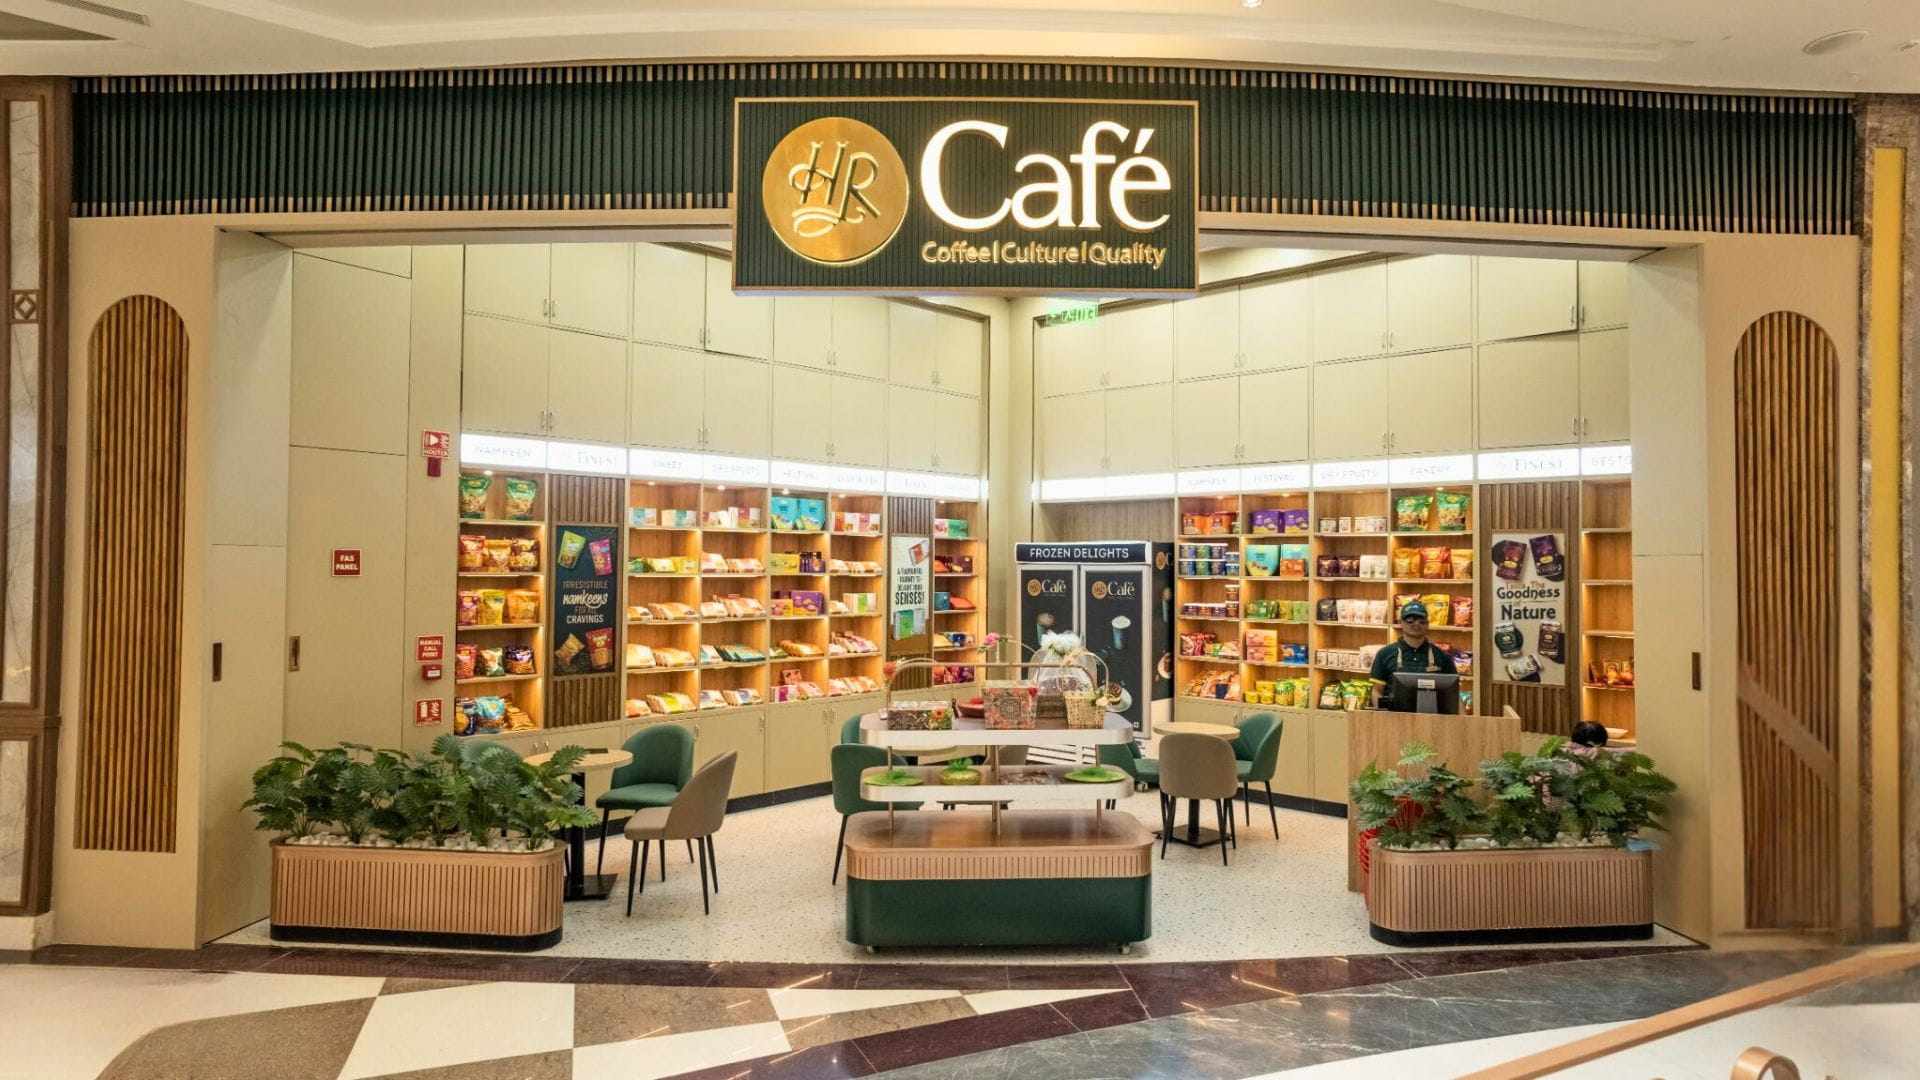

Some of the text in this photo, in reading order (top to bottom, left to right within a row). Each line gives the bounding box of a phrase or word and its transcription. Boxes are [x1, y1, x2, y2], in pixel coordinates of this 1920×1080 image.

[920, 120, 1172, 232] Café
[1030, 547, 1130, 559] FROZEN DELIGHTS
[563, 580, 609, 589] IRRESISTIBLE
[895, 591, 925, 605] SENSES!
[1496, 586, 1561, 600] Goodness
[566, 614, 605, 624] CRAVINGS
[1501, 604, 1556, 620] Nature
